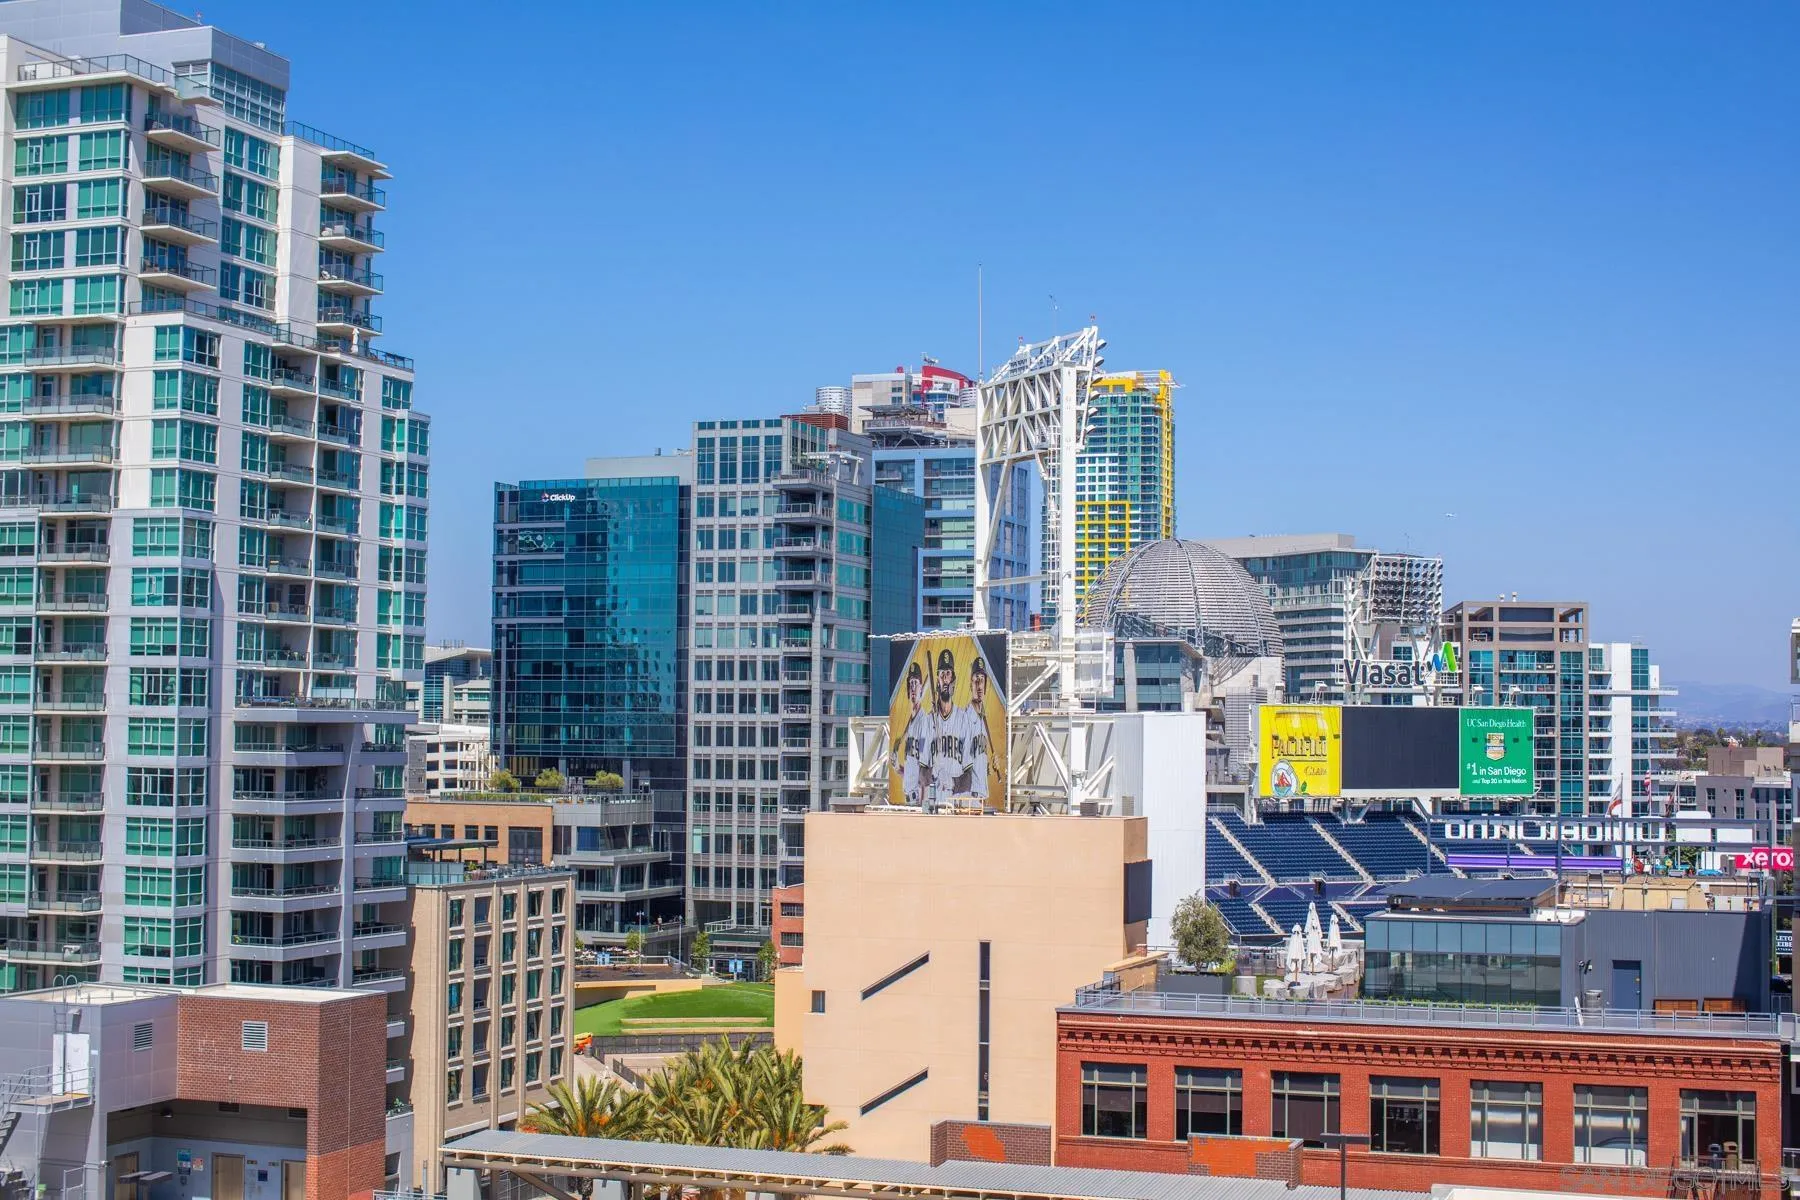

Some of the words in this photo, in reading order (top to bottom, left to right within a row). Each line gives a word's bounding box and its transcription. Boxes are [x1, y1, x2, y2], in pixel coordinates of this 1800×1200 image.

[550, 494, 576, 503] ClickUp
[1343, 658, 1425, 686] Viasat
[1466, 718, 1477, 728] UC
[1477, 718, 1489, 728] San
[1489, 718, 1507, 730] Diego
[1507, 718, 1527, 728] Health
[1466, 762, 1478, 776] #1
[1479, 766, 1487, 776] in
[1487, 766, 1503, 776] San
[1503, 766, 1527, 778] Diego
[1481, 777, 1491, 785] Top
